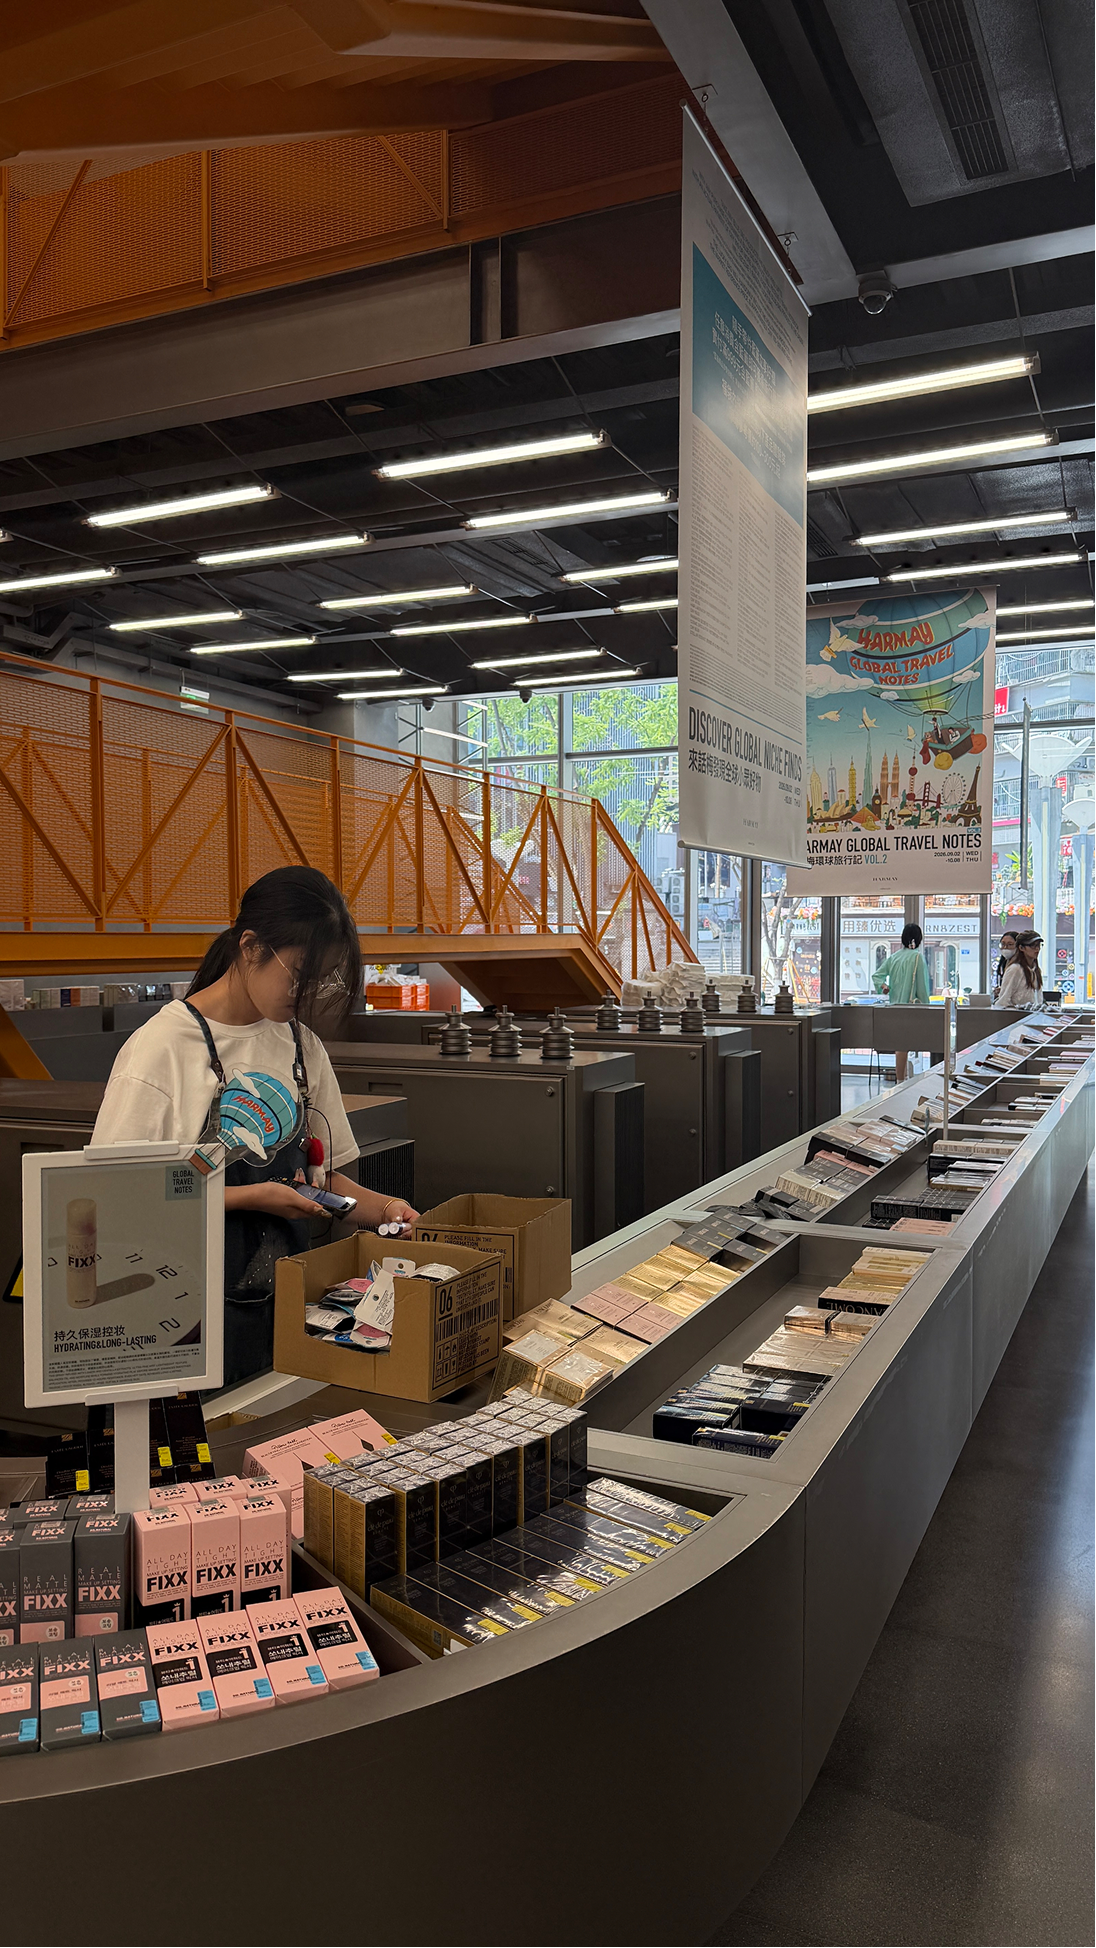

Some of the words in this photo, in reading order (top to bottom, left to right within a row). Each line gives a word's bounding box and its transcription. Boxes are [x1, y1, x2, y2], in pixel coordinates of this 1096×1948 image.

[857, 621, 935, 653] HARMAY
[850, 656, 901, 674] GLOBAL
[900, 644, 955, 671] TRAVEL
[878, 672, 920, 686] NOTES
[688, 706, 732, 756] DISCOVER
[734, 727, 763, 767] GLOBAL
[763, 740, 783, 776] NICHE
[784, 749, 802, 783] FINDS
[807, 838, 843, 854] ARMAY
[846, 837, 891, 853] GLOBAL
[894, 835, 938, 851] TRAVEL
[942, 833, 982, 849] NOTES
[807, 855, 863, 866] 梅環球旅行記
[864, 854, 888, 865] VOL.2
[842, 920, 896, 933] 用臻优选
[231, 1095, 275, 1133] HARMAY
[172, 1170, 194, 1178] GLOBAL
[172, 1178, 194, 1186] TRAVEL
[174, 1185, 193, 1194] NOTES
[444, 1234, 463, 1242] PLEASE
[68, 1254, 97, 1268] FIXX
[125, 1252, 143, 1264] 11
[156, 1264, 178, 1280] 12
[439, 1286, 453, 1315] 06
[827, 1302, 886, 1316] ANCOME
[53, 1325, 126, 1342] 持久保湿控妆
[53, 1335, 157, 1353] HYDRATING&LONG-LASTING
[204, 1481, 236, 1492] FIXX
[249, 1480, 280, 1489] FIXX
[25, 1505, 58, 1514] FIXX
[243, 1500, 275, 1511] FIXX
[146, 1512, 179, 1522] FIXX
[85, 1520, 119, 1528] FIXX
[31, 1527, 66, 1537] FIXX
[195, 1549, 212, 1557] ALL
[218, 1544, 237, 1552] DAY
[244, 1544, 260, 1553] ALL
[266, 1539, 284, 1548] DAY
[146, 1557, 164, 1565] ALL
[170, 1552, 188, 1561] DAY
[196, 1551, 237, 1562] TIGHT
[244, 1547, 284, 1559] TIGHT
[146, 1558, 188, 1570] TIGHT
[217, 1557, 237, 1565] SETTING
[78, 1566, 120, 1575] REAL
[167, 1565, 188, 1573] SETTING
[196, 1563, 236, 1584] FIXX
[244, 1558, 284, 1579] FIXX
[23, 1574, 67, 1583] REAL
[78, 1573, 121, 1581] MATTE
[146, 1570, 188, 1592] FIXX
[23, 1581, 68, 1589] MATTE
[78, 1585, 121, 1602] FIXX
[23, 1593, 68, 1611] FIXX
[222, 1598, 229, 1612] 1
[172, 1606, 180, 1621] 1
[306, 1607, 347, 1620] FIXX
[257, 1619, 301, 1633] FIXX
[338, 1623, 348, 1632] 1
[207, 1631, 251, 1646] FIXX
[290, 1636, 300, 1646] 1
[154, 1641, 199, 1656] FIXX
[239, 1649, 249, 1659] 1
[100, 1651, 146, 1667] FIXX
[186, 1660, 195, 1670] 1
[0, 1667, 34, 1680] IXX
[44, 1660, 91, 1675] FIXX
